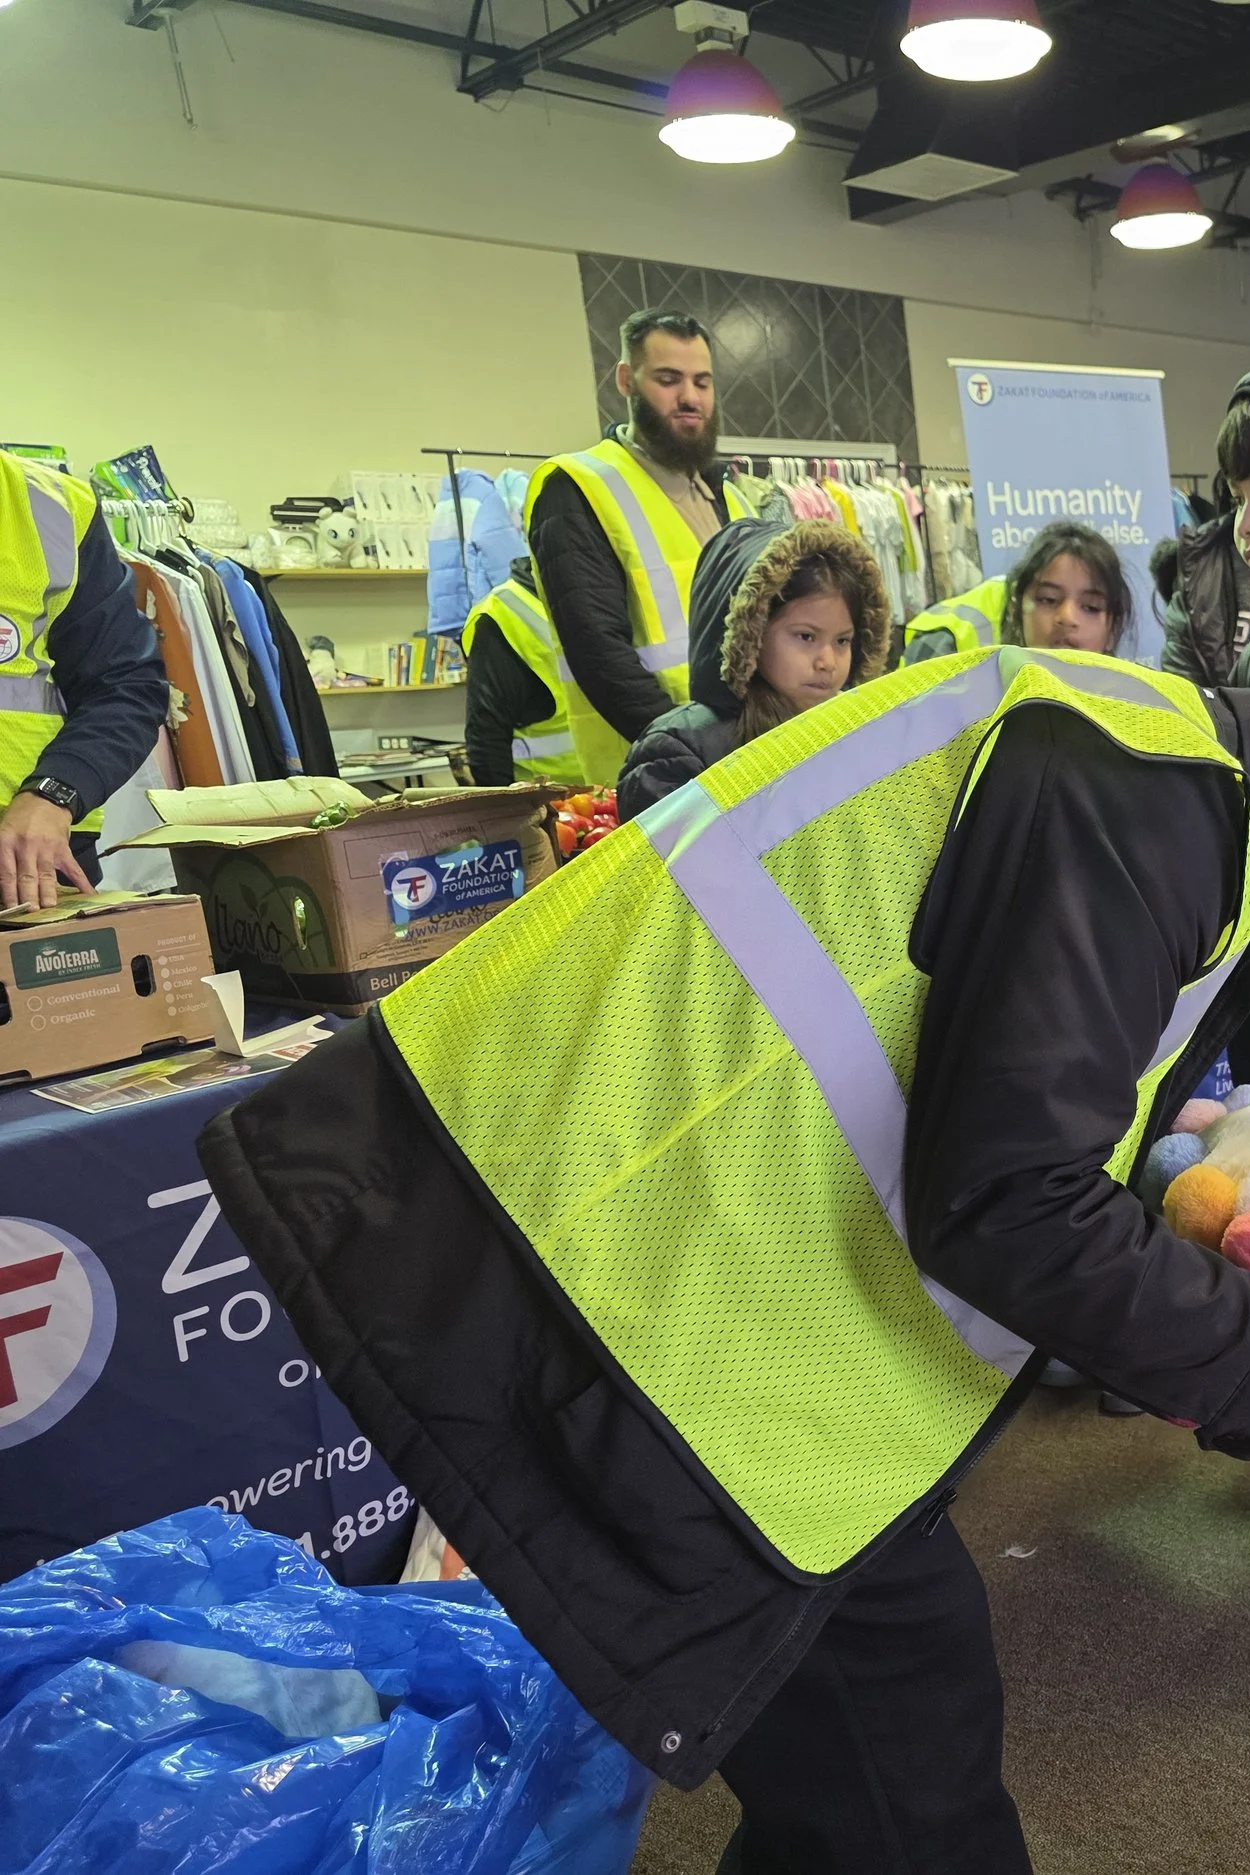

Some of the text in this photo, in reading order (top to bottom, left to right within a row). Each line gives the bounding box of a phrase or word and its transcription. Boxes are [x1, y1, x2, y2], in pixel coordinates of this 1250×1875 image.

[1031, 387, 1097, 400] FOUNDATION
[1107, 390, 1151, 402] AMERICA
[986, 478, 1143, 524] Humanity
[991, 520, 1040, 549] abo
[1101, 519, 1150, 545] else.
[439, 849, 519, 884] ZAKAT
[442, 868, 520, 895] FOUNDATION
[465, 883, 506, 899] AMERICA
[170, 964, 198, 976] Mexico
[370, 972, 399, 991] Bell
[46, 983, 121, 1006] Conventional
[50, 1008, 96, 1025] Organic
